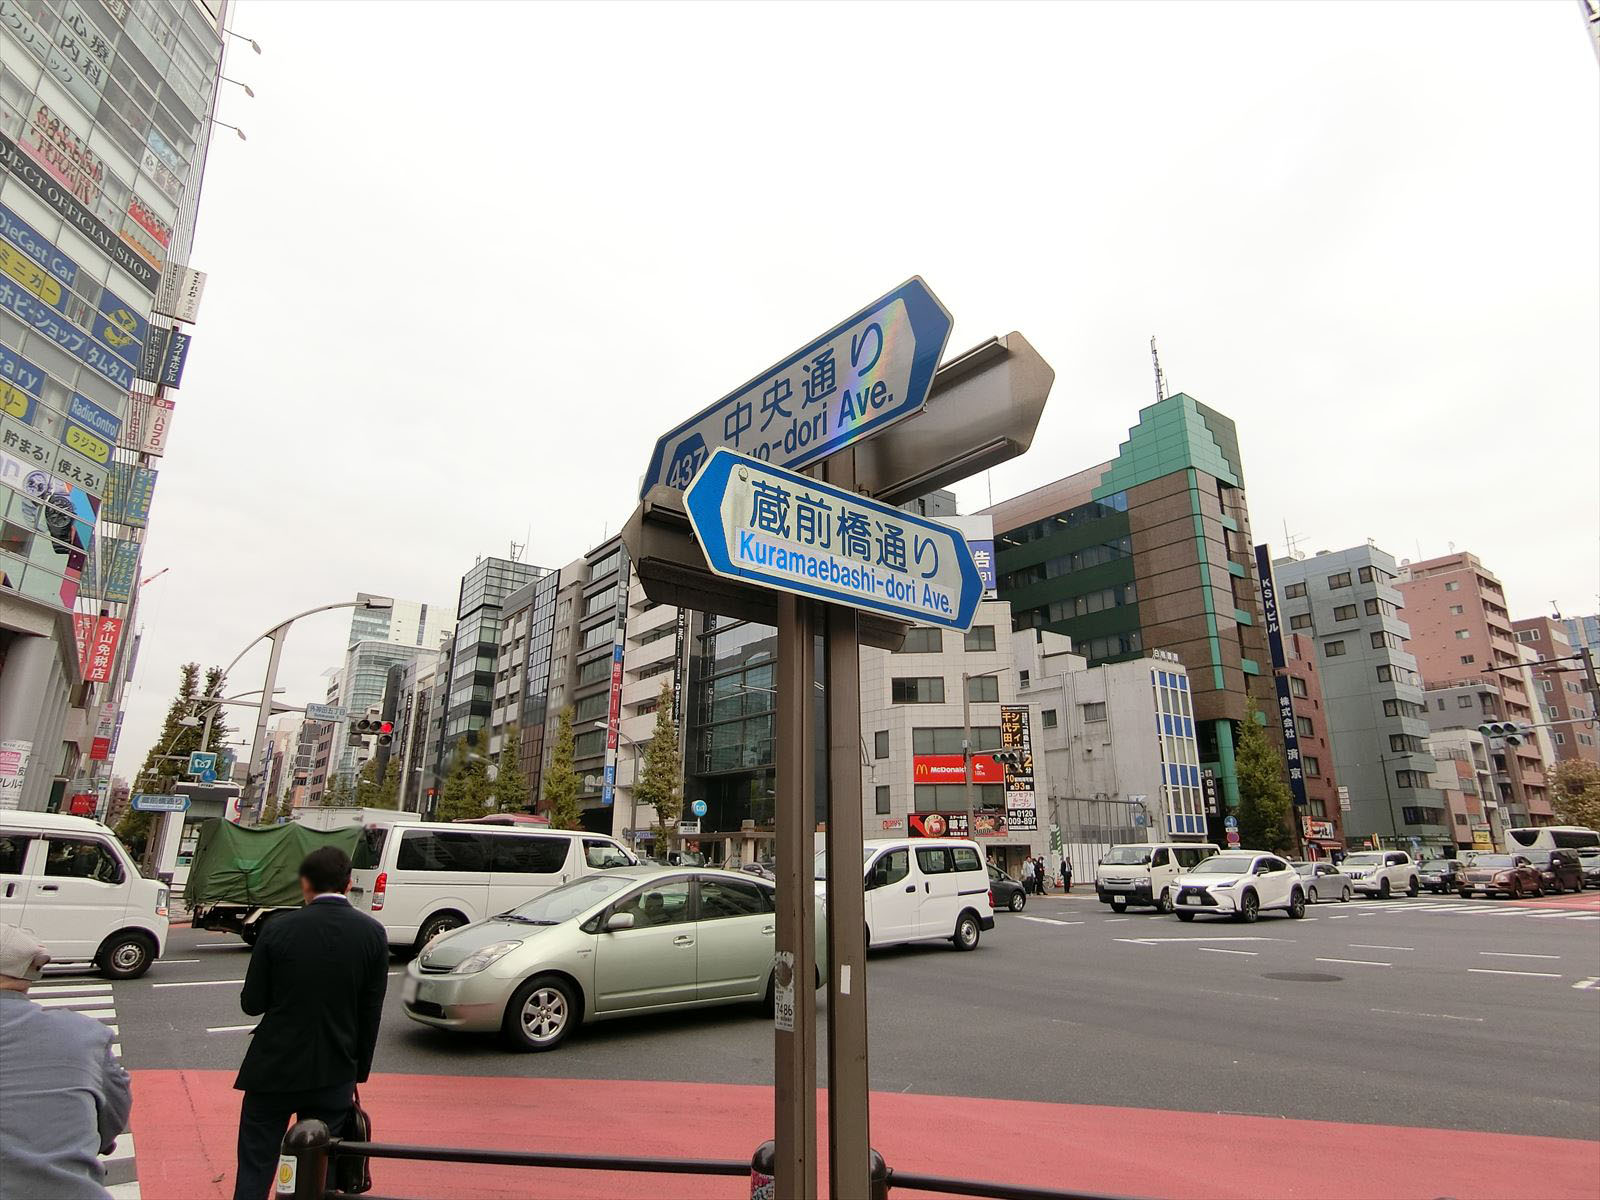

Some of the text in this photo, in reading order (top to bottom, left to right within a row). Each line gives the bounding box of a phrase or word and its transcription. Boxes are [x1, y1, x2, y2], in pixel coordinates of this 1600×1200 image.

[60, 35, 102, 85] 内科
[66, 15, 111, 63] 心療
[47, 187, 113, 251] OFFICIAL
[116, 247, 151, 280] SHOP
[52, 257, 75, 282] Car
[88, 346, 129, 388] タムタム
[723, 322, 884, 448] 中央通り
[837, 380, 894, 429] Ave.
[73, 431, 107, 458] ラジコン
[670, 445, 706, 489] 437
[750, 479, 940, 580] 蔵前橋通り
[740, 530, 953, 614] Kuramaebashi-dori Ave.
[1261, 578, 1279, 634] KSKビル
[91, 620, 117, 680] 永山免税店
[1280, 696, 1296, 739] 株式会社
[1016, 809, 1034, 818] 0120
